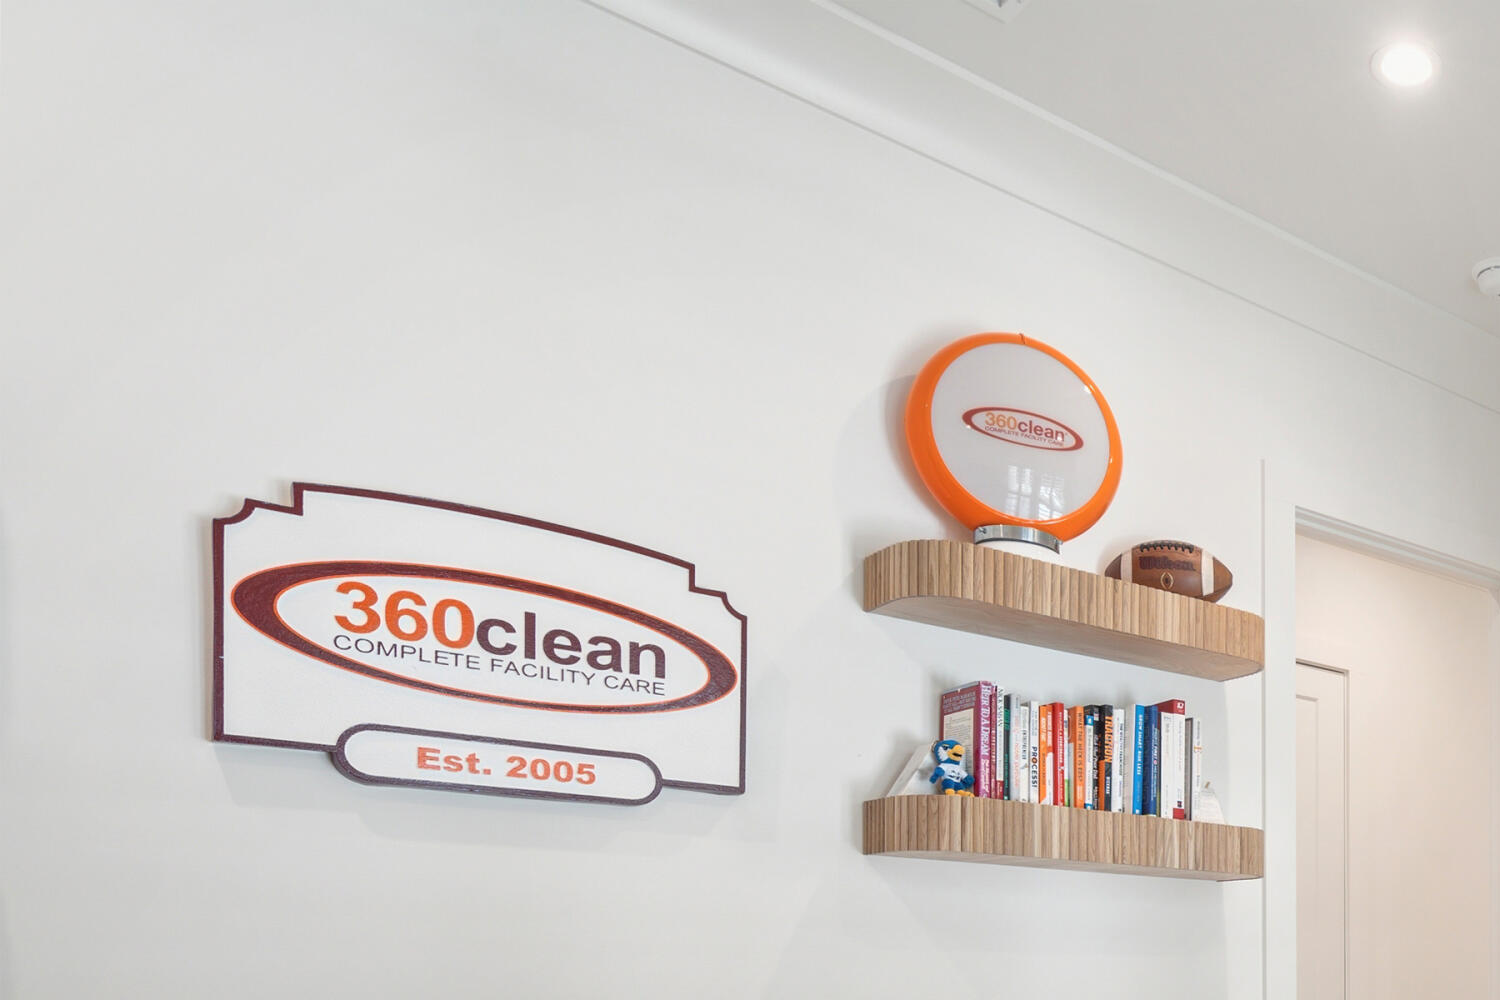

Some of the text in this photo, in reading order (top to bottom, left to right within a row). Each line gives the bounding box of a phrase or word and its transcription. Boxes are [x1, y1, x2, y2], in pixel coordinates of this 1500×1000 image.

[985, 412, 1064, 442] 360clean
[334, 581, 666, 679] 360clean
[333, 634, 666, 696] COMPLETE FACILITY CARE
[1104, 716, 1113, 763] TRACTION
[417, 746, 596, 785] Est. 2005
